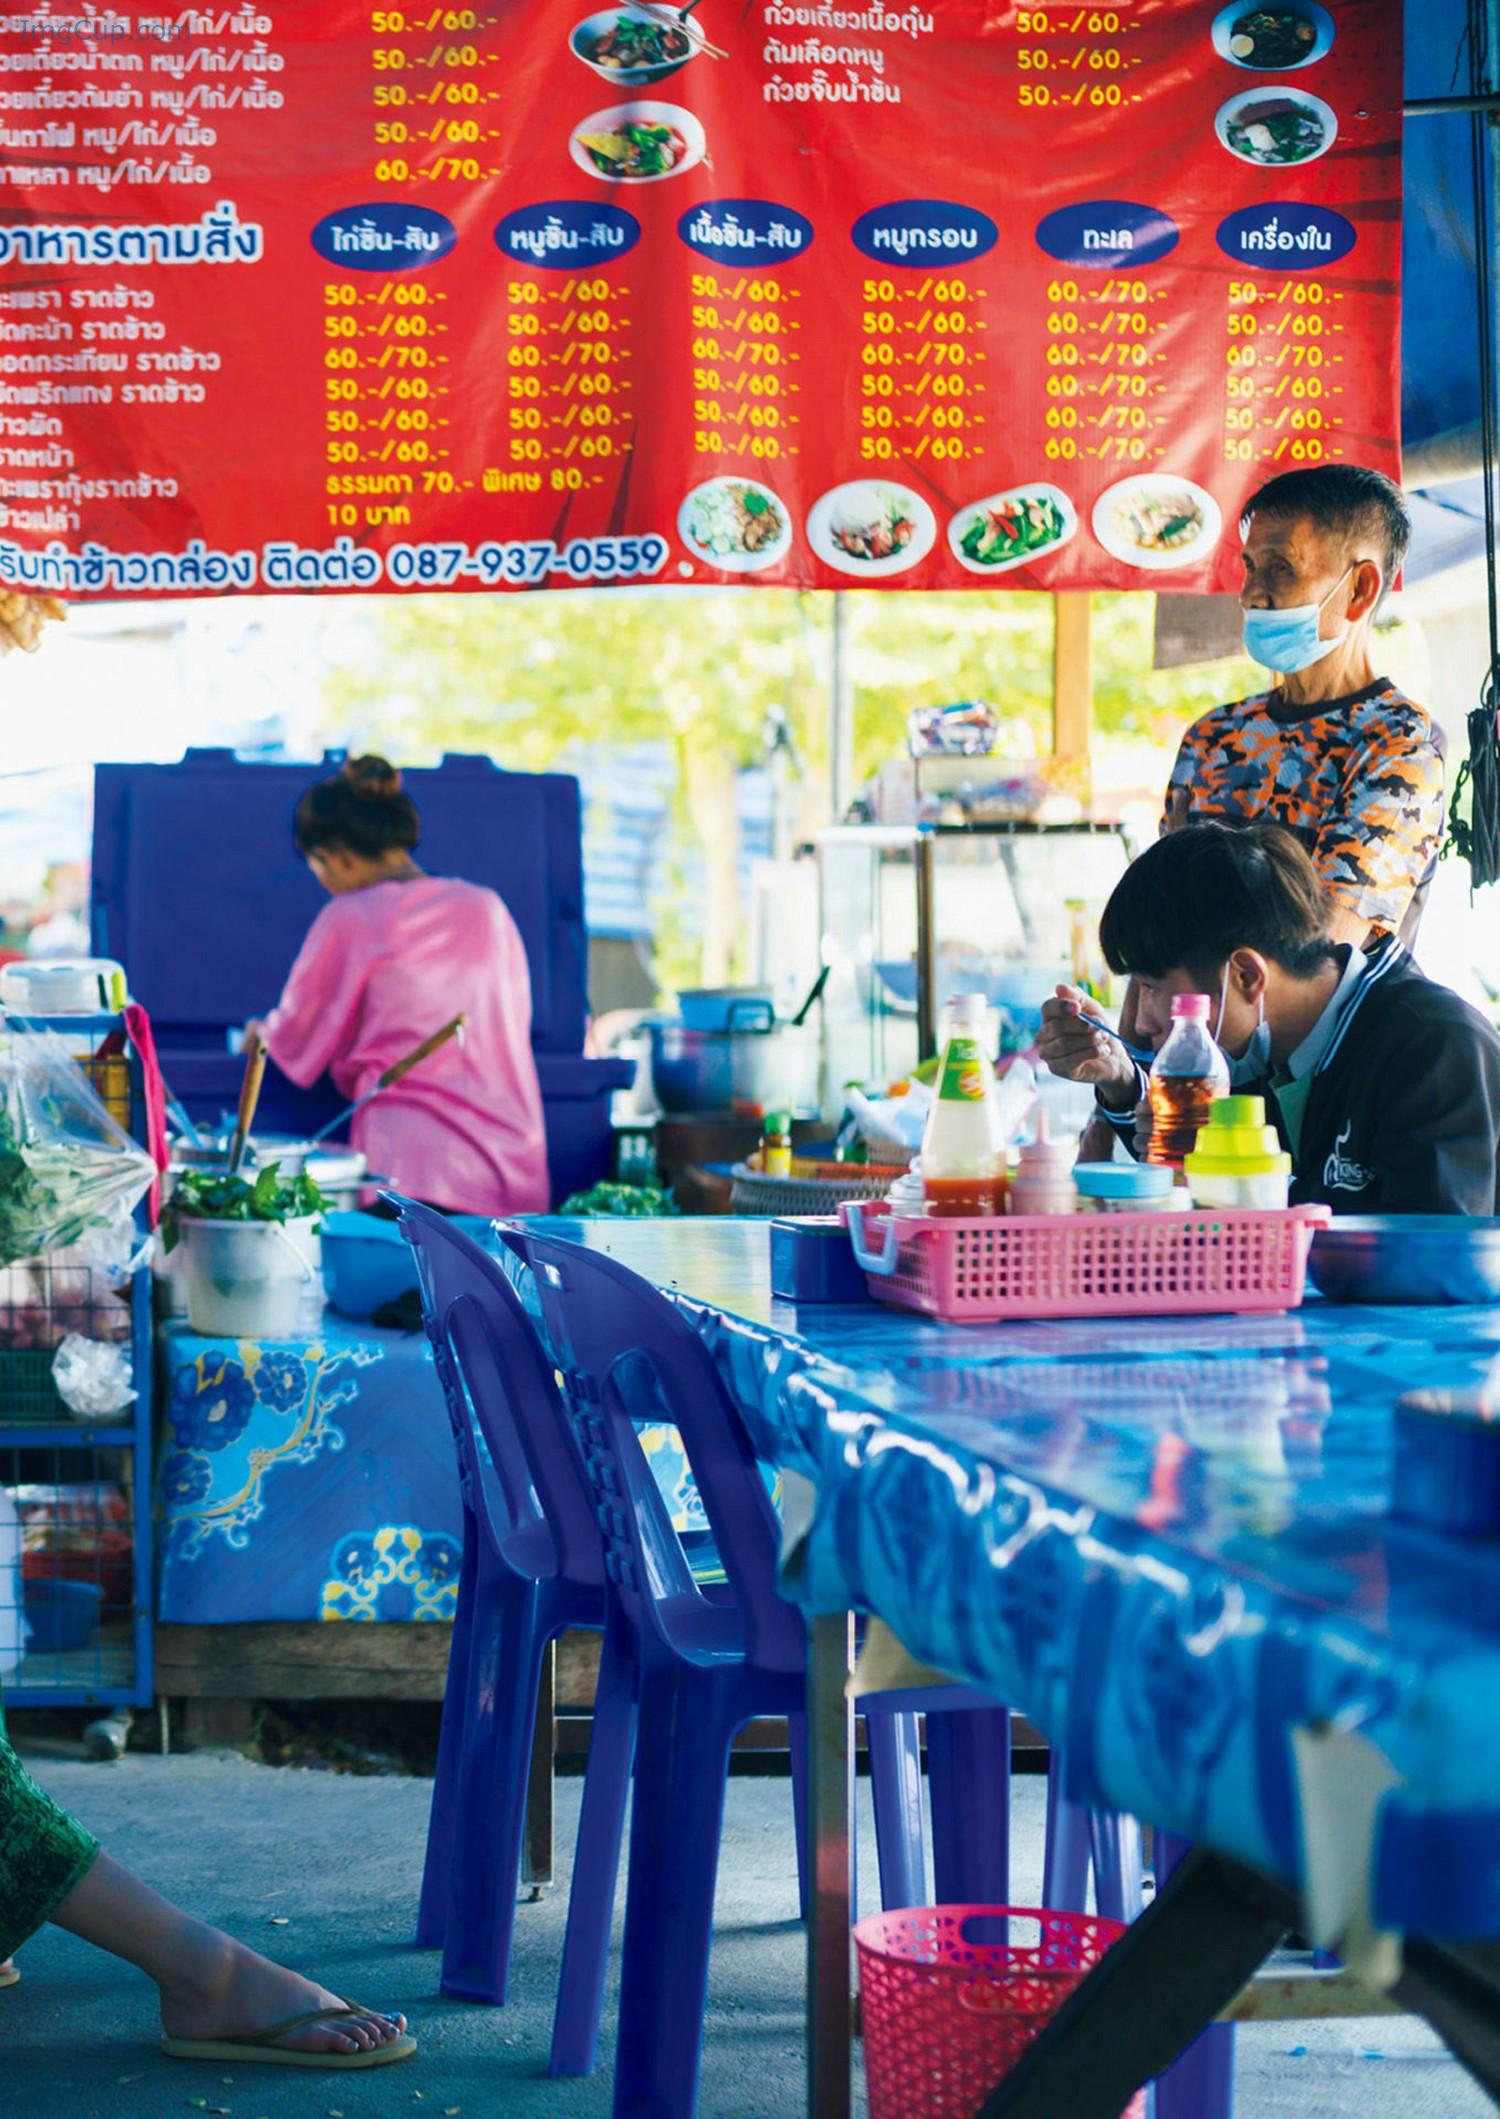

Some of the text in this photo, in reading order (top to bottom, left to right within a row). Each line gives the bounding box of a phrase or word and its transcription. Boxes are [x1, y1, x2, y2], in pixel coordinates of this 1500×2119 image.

[372, 9, 498, 33] 50.-/60.-
[1017, 10, 1140, 33] 50.-/60.-
[373, 46, 500, 70] 50.-/60.-
[763, 37, 885, 74] ต้มเลือดหมู
[1018, 48, 1141, 70] 50.-/60.-
[374, 82, 500, 106] 50.-/60.-
[1018, 84, 1143, 106] 50.-/60.-
[375, 119, 500, 143] 50.-/60.-
[375, 157, 501, 181] 60.-/70.-
[874, 226, 978, 256] หมูกรอบ
[1083, 226, 1133, 250] ทะเล
[1241, 217, 1332, 251] เครื่องใน
[70, 283, 154, 309] ราดข้าว
[325, 282, 448, 306] 50.-/60.-
[507, 279, 630, 305] 50.-/60.-
[691, 274, 801, 303] 50.-/60.-
[863, 278, 987, 302] 50.-/60.-
[1046, 279, 1168, 304] 60.-/70.-
[1228, 280, 1344, 305] 50.-/60.-
[81, 316, 165, 340] ราดข้าว
[325, 314, 449, 338] 50.-/60.-
[507, 310, 631, 336] 50.-/60.-
[692, 305, 801, 334] 50.-/60.-
[862, 309, 987, 334] 50.-/60.-
[1046, 309, 1169, 335] 60.-/70.-
[1226, 311, 1344, 337] 50.-/60.-
[136, 347, 221, 372] ราดข้าว
[324, 345, 449, 369] 60.-/70.-
[507, 341, 632, 367] 60.-/70.-
[692, 336, 801, 366] 60.-/70.-
[861, 341, 986, 366] 60.-/70.-
[1045, 341, 1168, 367] 60.-/70.-
[1225, 342, 1344, 369] 60.-/70.-
[121, 378, 206, 403] ราดข้าว
[326, 376, 449, 401] 50.-/60.-
[509, 373, 632, 398] 50.-/60.-
[693, 367, 800, 397] 50.-/60.-
[862, 372, 986, 397] 50.-/60.-
[1045, 372, 1167, 398] 60.-/70.-
[1225, 373, 1344, 400] 50.-/60.-
[326, 408, 449, 432] 50.-/60.-
[509, 404, 632, 429] 50.-/60.-
[694, 399, 800, 429] 50.-/60.-
[861, 404, 985, 428] 50.-/60.-
[1045, 403, 1166, 430] 60.-/70.-
[1224, 405, 1344, 431] 50.-/60.-
[327, 439, 450, 463] 50.-/60.-
[510, 435, 633, 461] 50.-/60.-
[695, 430, 800, 460] 50.-/60.-
[861, 435, 984, 460] 50.-/60.-
[1044, 435, 1166, 461] 60.-/70.-
[1223, 436, 1344, 461] 50.-/60.-
[326, 468, 604, 495] ธรรมดา 70.- พิเศษ 80.-
[327, 505, 411, 526] 10 บาท
[0, 537, 666, 588] รับทำข้าวกล่อง ติดต่อ 087-937-0559
